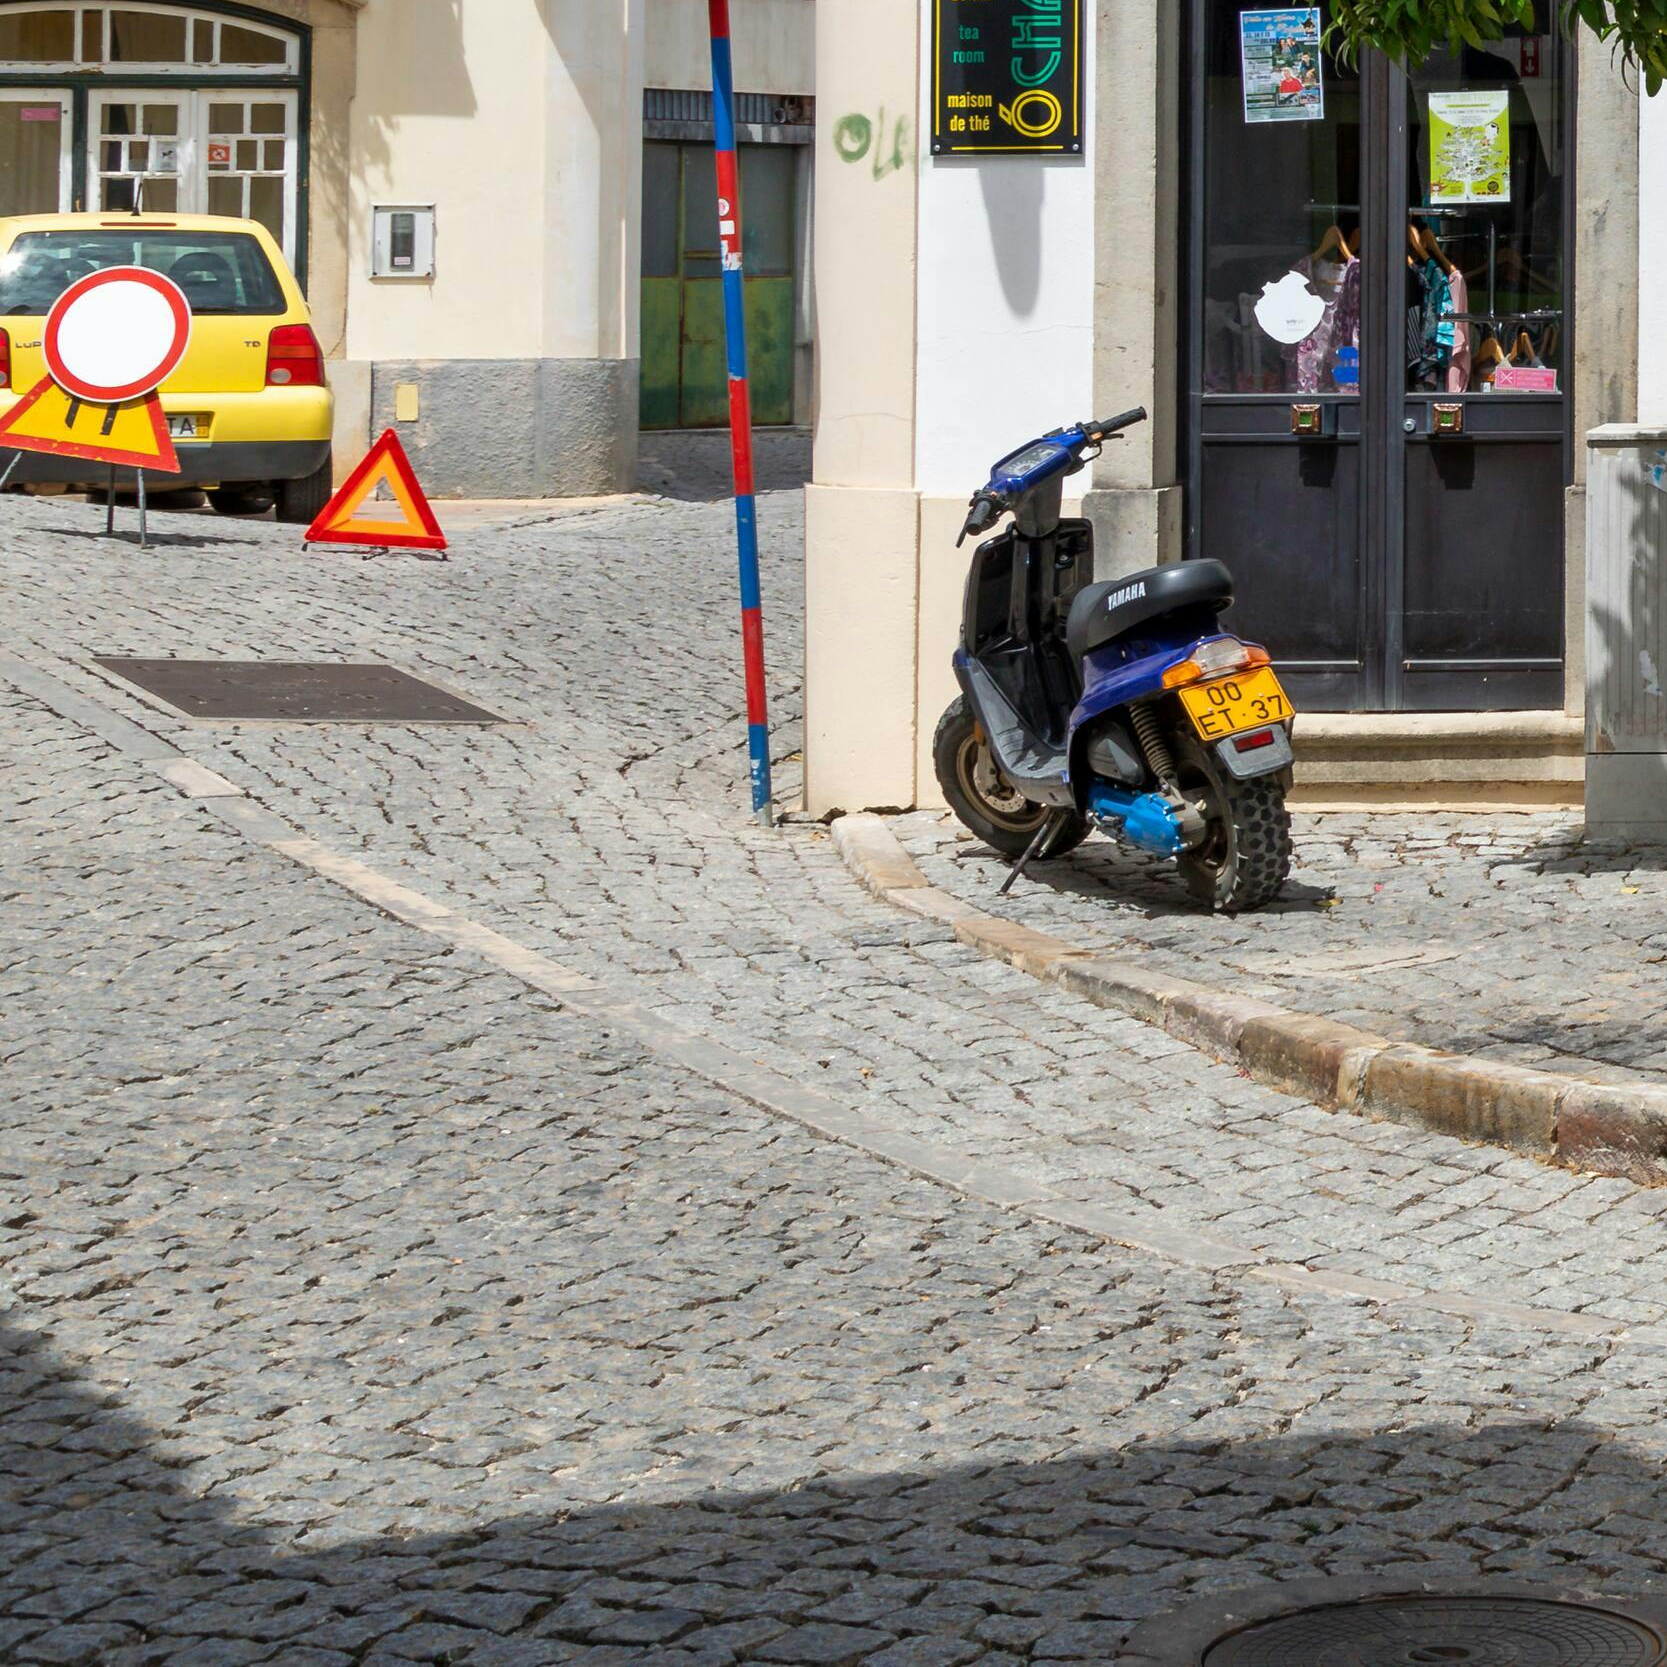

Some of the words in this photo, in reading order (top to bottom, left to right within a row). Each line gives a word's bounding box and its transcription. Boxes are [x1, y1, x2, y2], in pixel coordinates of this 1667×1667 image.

[959, 24, 980, 40] tea
[953, 50, 985, 64] room
[947, 91, 993, 108] maison
[950, 115, 966, 131] de
[969, 115, 990, 131] thé
[15, 340, 42, 349] LUP
[1108, 582, 1146, 611] YAMAHA
[1206, 681, 1242, 706] 00
